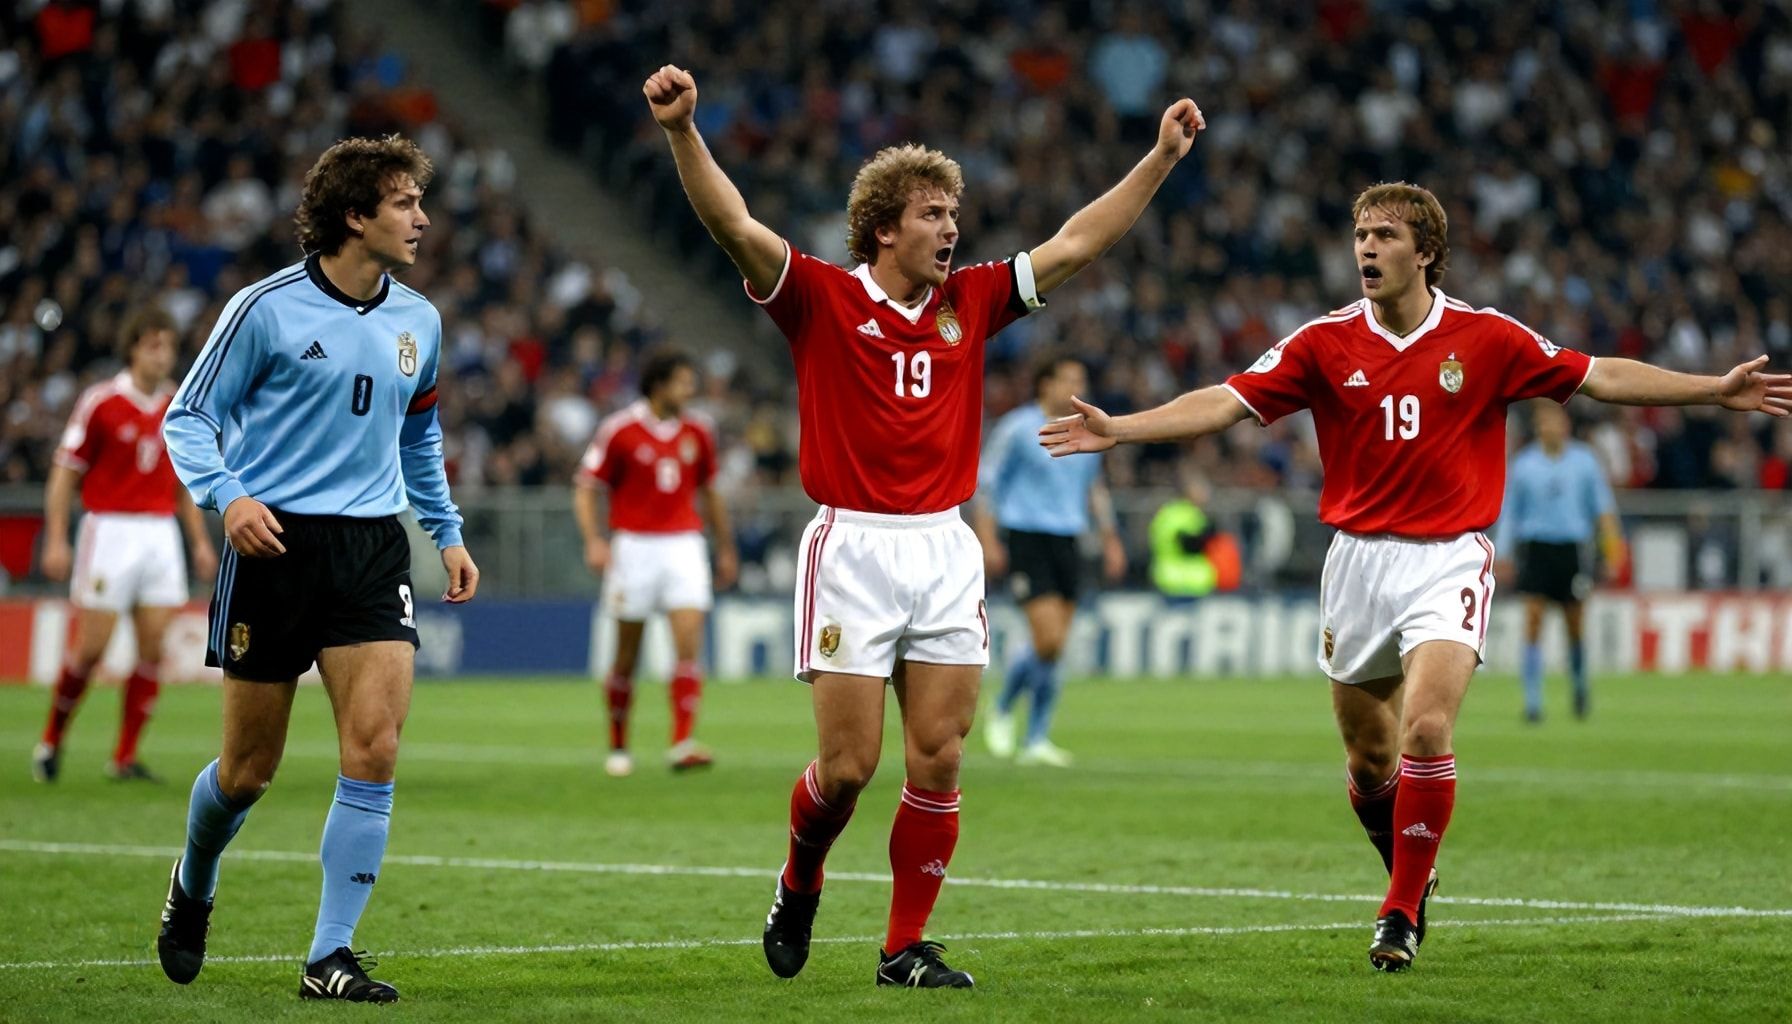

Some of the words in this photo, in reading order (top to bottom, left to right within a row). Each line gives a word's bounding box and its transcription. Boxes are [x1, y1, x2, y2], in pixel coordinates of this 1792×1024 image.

[891, 351, 932, 398] 19
[1379, 394, 1420, 441] 19
[1460, 587, 1476, 632] 2
